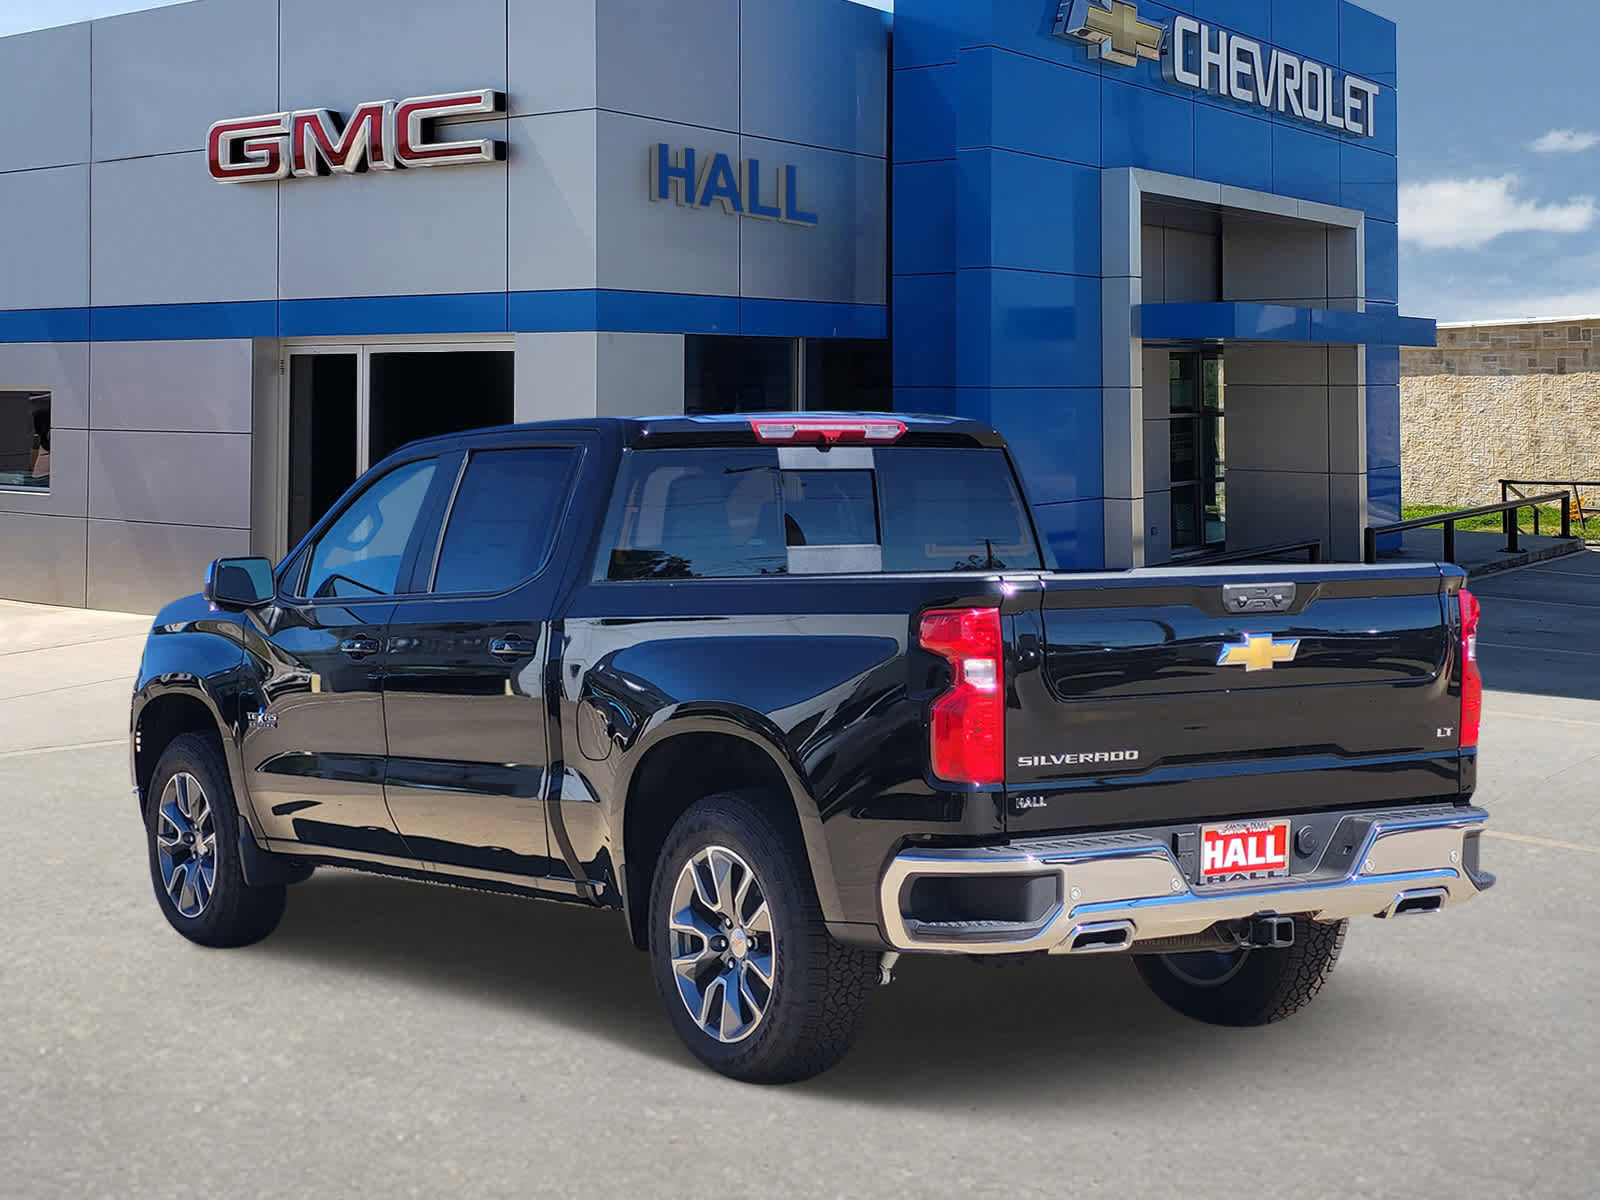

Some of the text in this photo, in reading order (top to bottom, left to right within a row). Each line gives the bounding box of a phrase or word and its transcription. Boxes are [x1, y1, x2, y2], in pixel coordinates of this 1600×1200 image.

[1173, 15, 1380, 137] CHEVROLET
[206, 88, 507, 185] GMC
[649, 142, 819, 227] HALL
[1436, 727, 1454, 738] LT
[1017, 750, 1139, 767] SILVERADO
[1015, 796, 1048, 809] HALL
[1203, 834, 1284, 871] HALL
[1206, 870, 1284, 884] HALL
